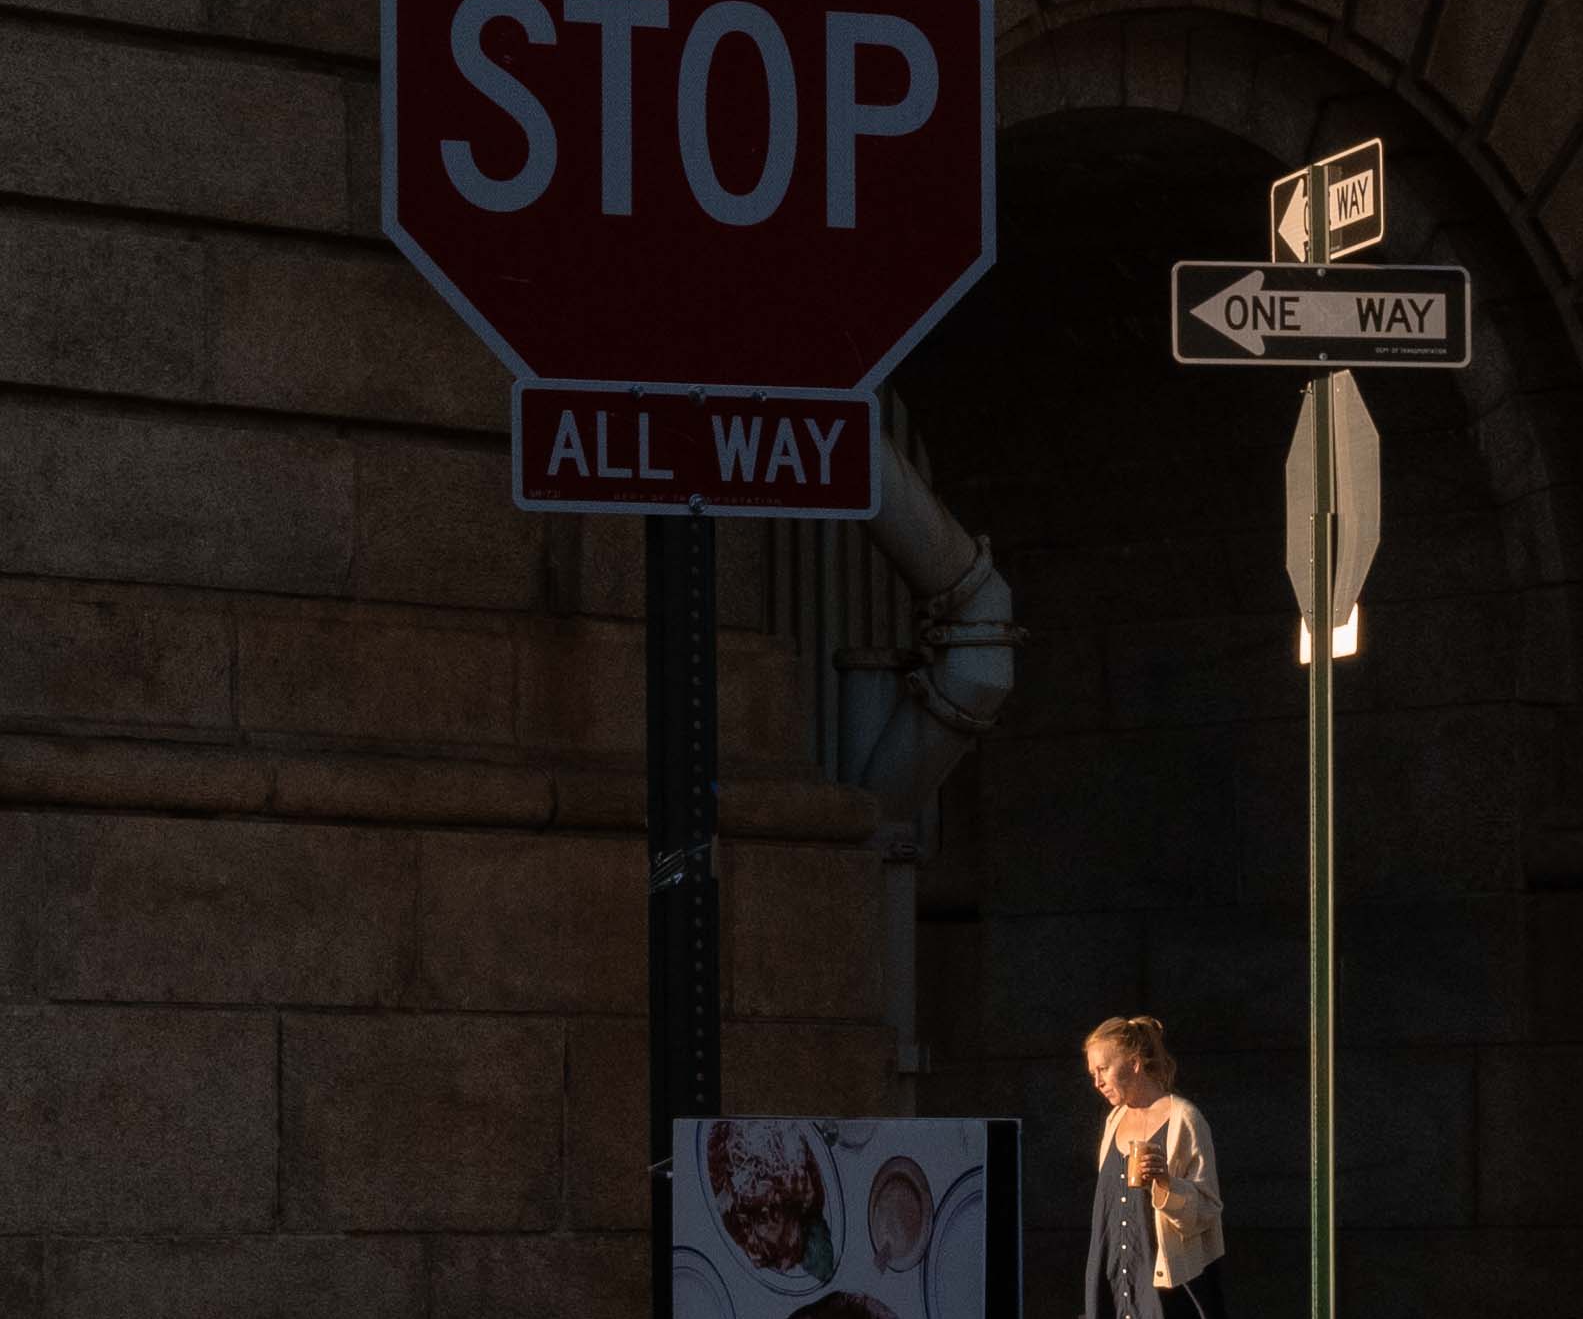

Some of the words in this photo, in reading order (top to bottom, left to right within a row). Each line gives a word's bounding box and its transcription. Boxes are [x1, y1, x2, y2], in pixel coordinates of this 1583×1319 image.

[1336, 176, 1369, 222] WAY
[1224, 295, 1302, 332] ONE
[1355, 297, 1435, 334] WAY
[546, 409, 675, 480] ALL
[711, 414, 846, 486] WAY
